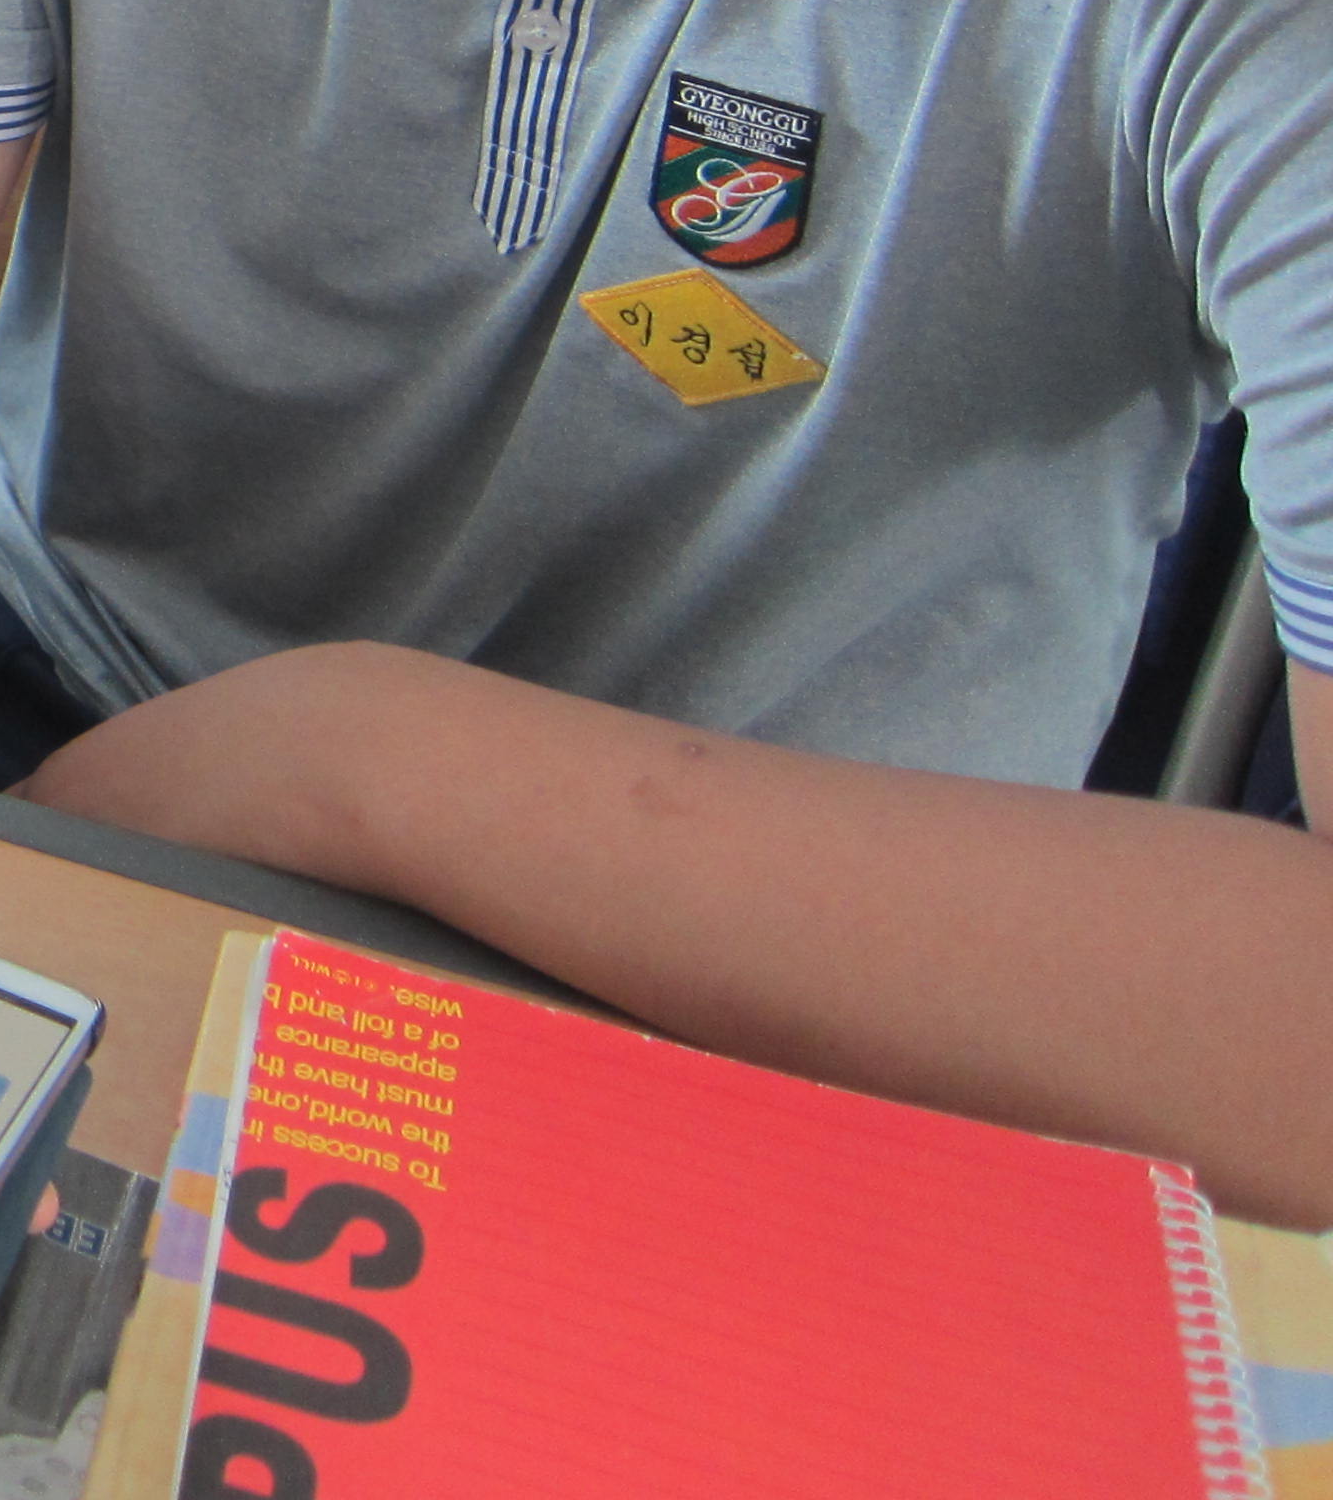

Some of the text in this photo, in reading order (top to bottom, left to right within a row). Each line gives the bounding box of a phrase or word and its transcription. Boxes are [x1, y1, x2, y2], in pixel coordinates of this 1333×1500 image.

[680, 87, 808, 134] GYEONGGU
[687, 111, 797, 149] HIGH SCHOOL
[704, 126, 743, 145] SINCE
[288, 990, 346, 1023] and
[390, 984, 463, 1019] wise.
[352, 1011, 396, 1040] foll
[403, 1023, 421, 1040] a
[428, 1028, 462, 1052] of
[276, 1023, 458, 1082] appearance
[293, 1061, 368, 1096] have
[377, 1084, 454, 1117] must
[273, 1127, 401, 1173] success
[401, 1123, 452, 1155] the
[407, 1162, 448, 1192] To
